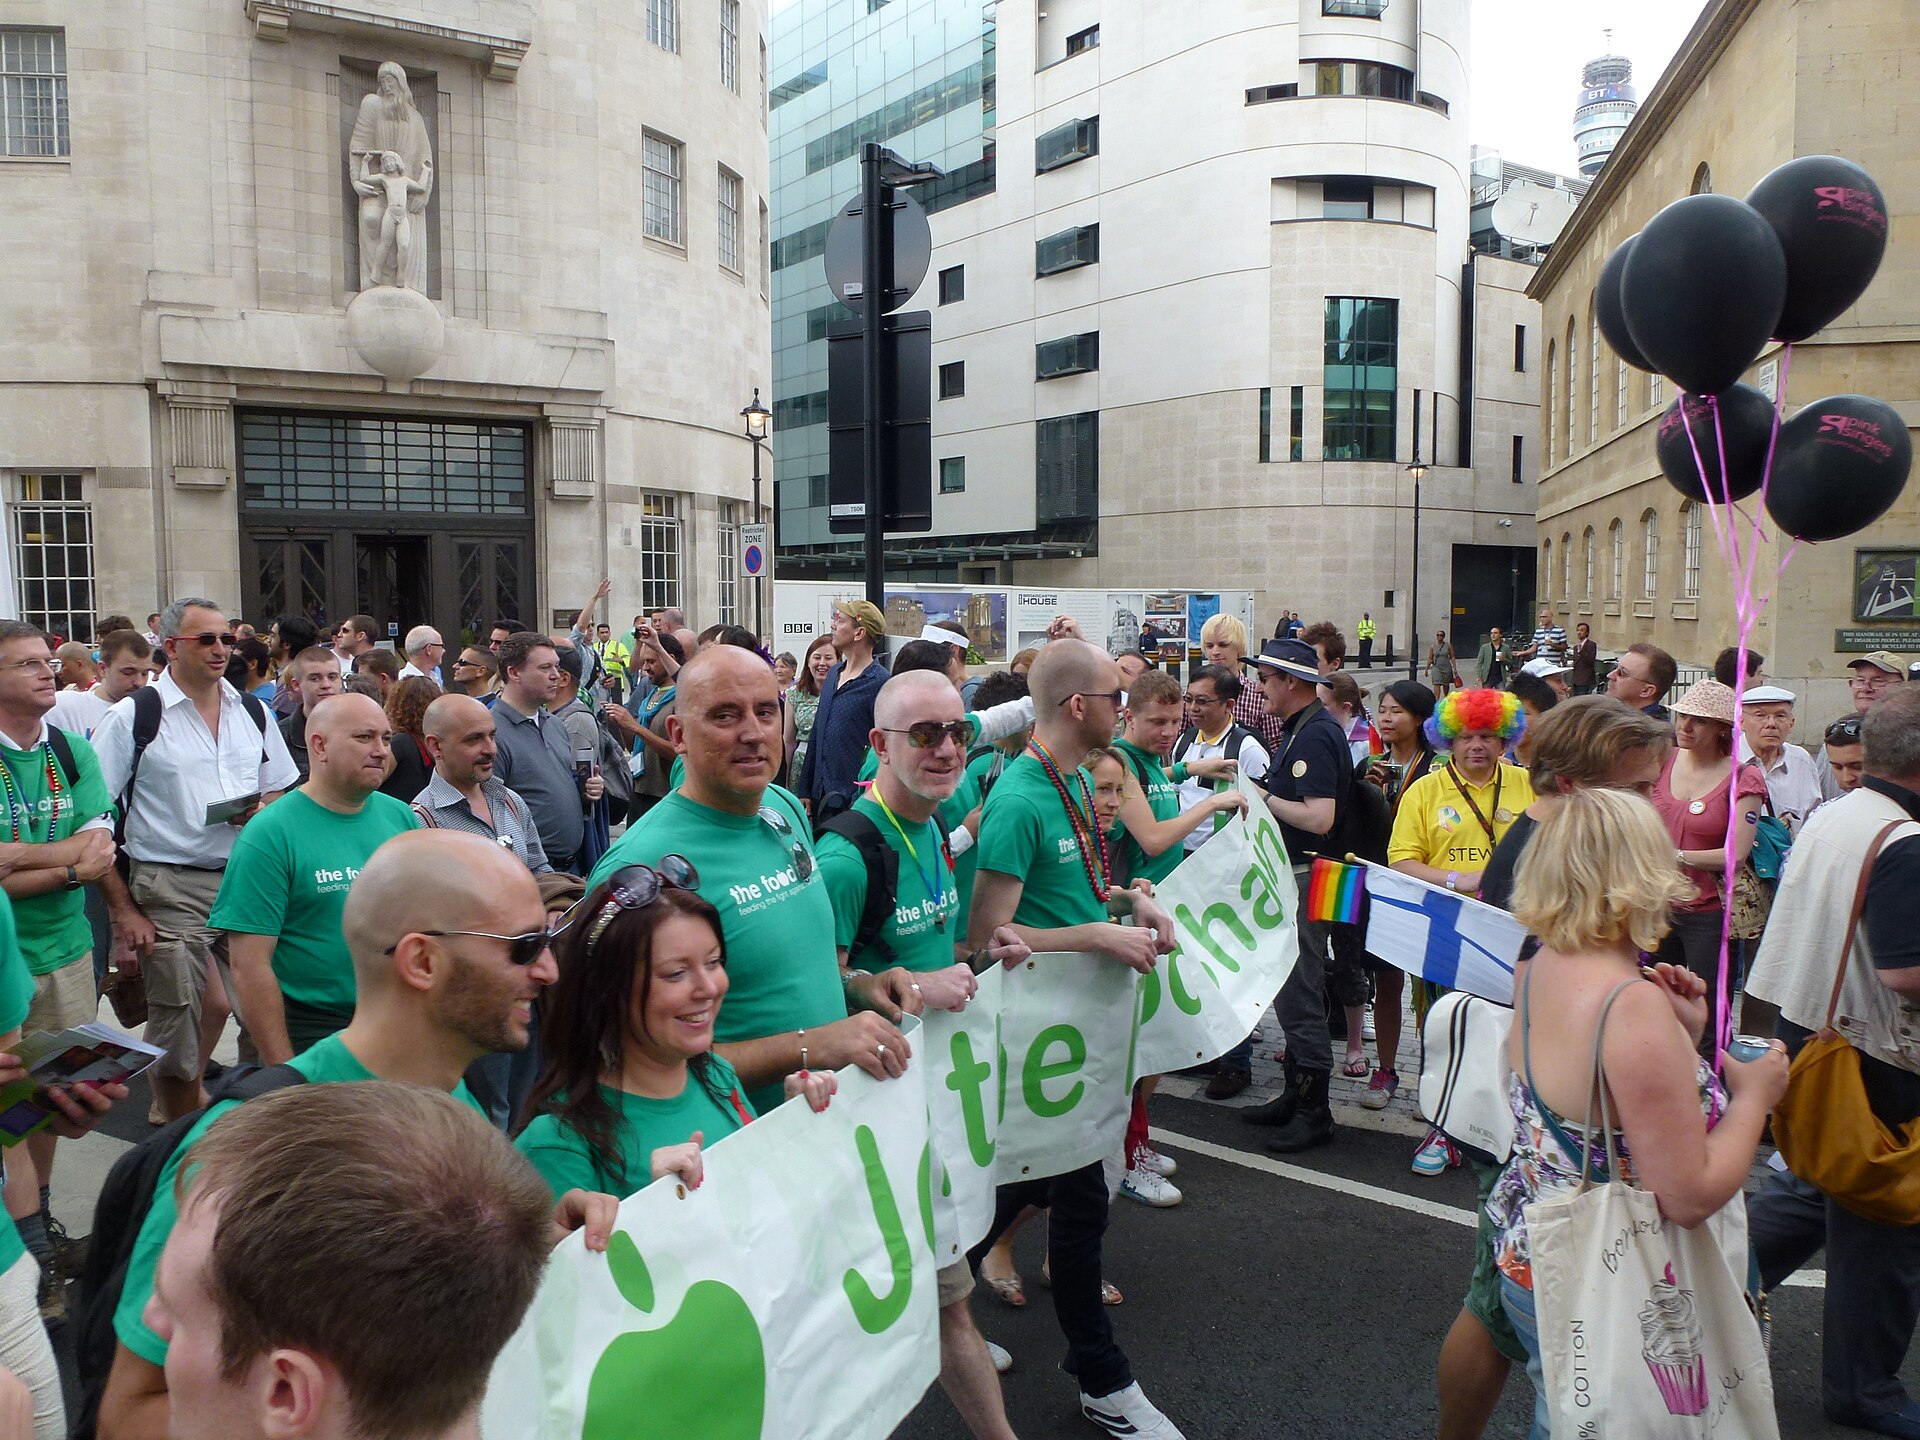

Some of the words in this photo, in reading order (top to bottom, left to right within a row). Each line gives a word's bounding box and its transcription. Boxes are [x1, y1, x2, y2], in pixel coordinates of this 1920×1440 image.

[1588, 88, 1607, 100] BT
[1847, 417, 1880, 434] pink
[1843, 427, 1892, 457] singers
[745, 535, 761, 543] ZONE
[784, 623, 812, 633] BBC
[1058, 838, 1075, 853] the
[1449, 848, 1492, 862] STEW
[315, 869, 343, 883] the
[317, 883, 350, 893] feeding
[729, 884, 762, 904] the
[739, 901, 766, 916] feeding
[896, 906, 920, 924] the
[896, 922, 926, 936] feeding
[1570, 1320, 1591, 1408] COTTON
